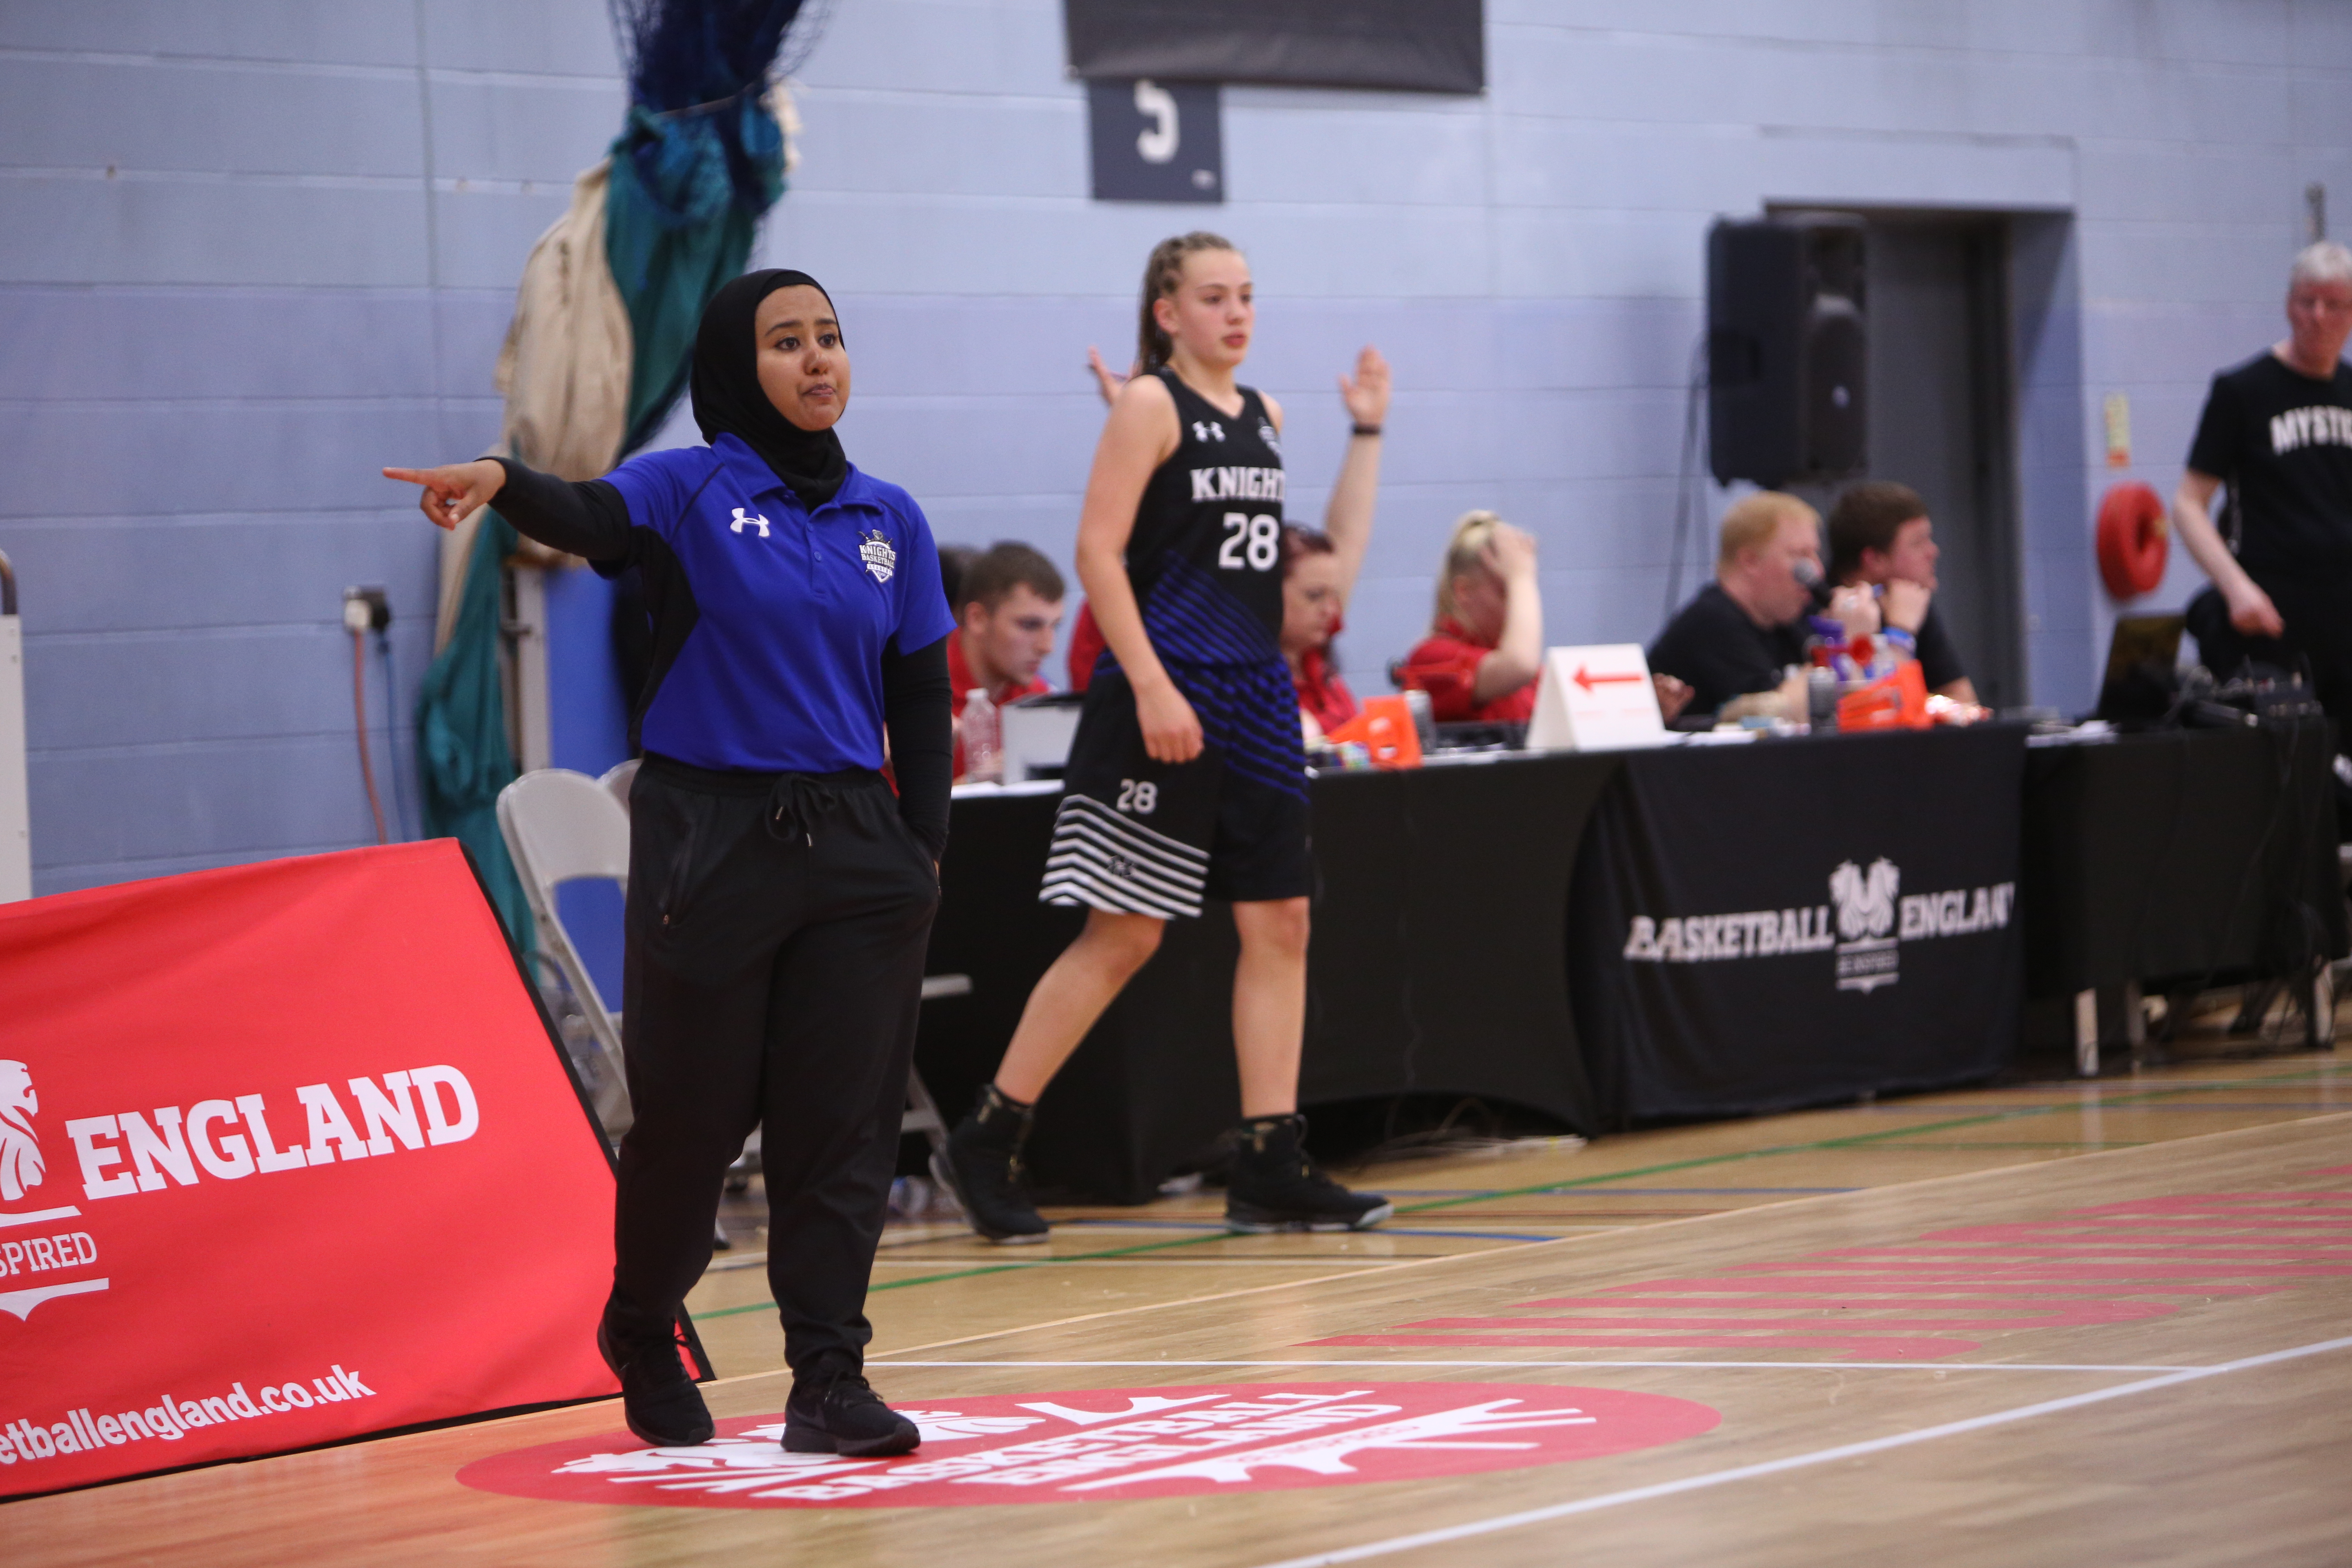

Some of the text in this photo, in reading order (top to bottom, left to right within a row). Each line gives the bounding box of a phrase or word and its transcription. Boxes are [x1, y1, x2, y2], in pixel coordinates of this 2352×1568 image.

[859, 545, 895, 561] KNIGHTS
[861, 554, 894, 569] BASKETBALL
[1218, 512, 1280, 571] 28
[1117, 778, 1158, 814] 28
[1624, 905, 1835, 963] BASKETBALL
[65, 1065, 479, 1200] ENGLAND
[748, 1390, 1376, 1501] BASKETBALL
[947, 1404, 1403, 1486] ENGLAND
